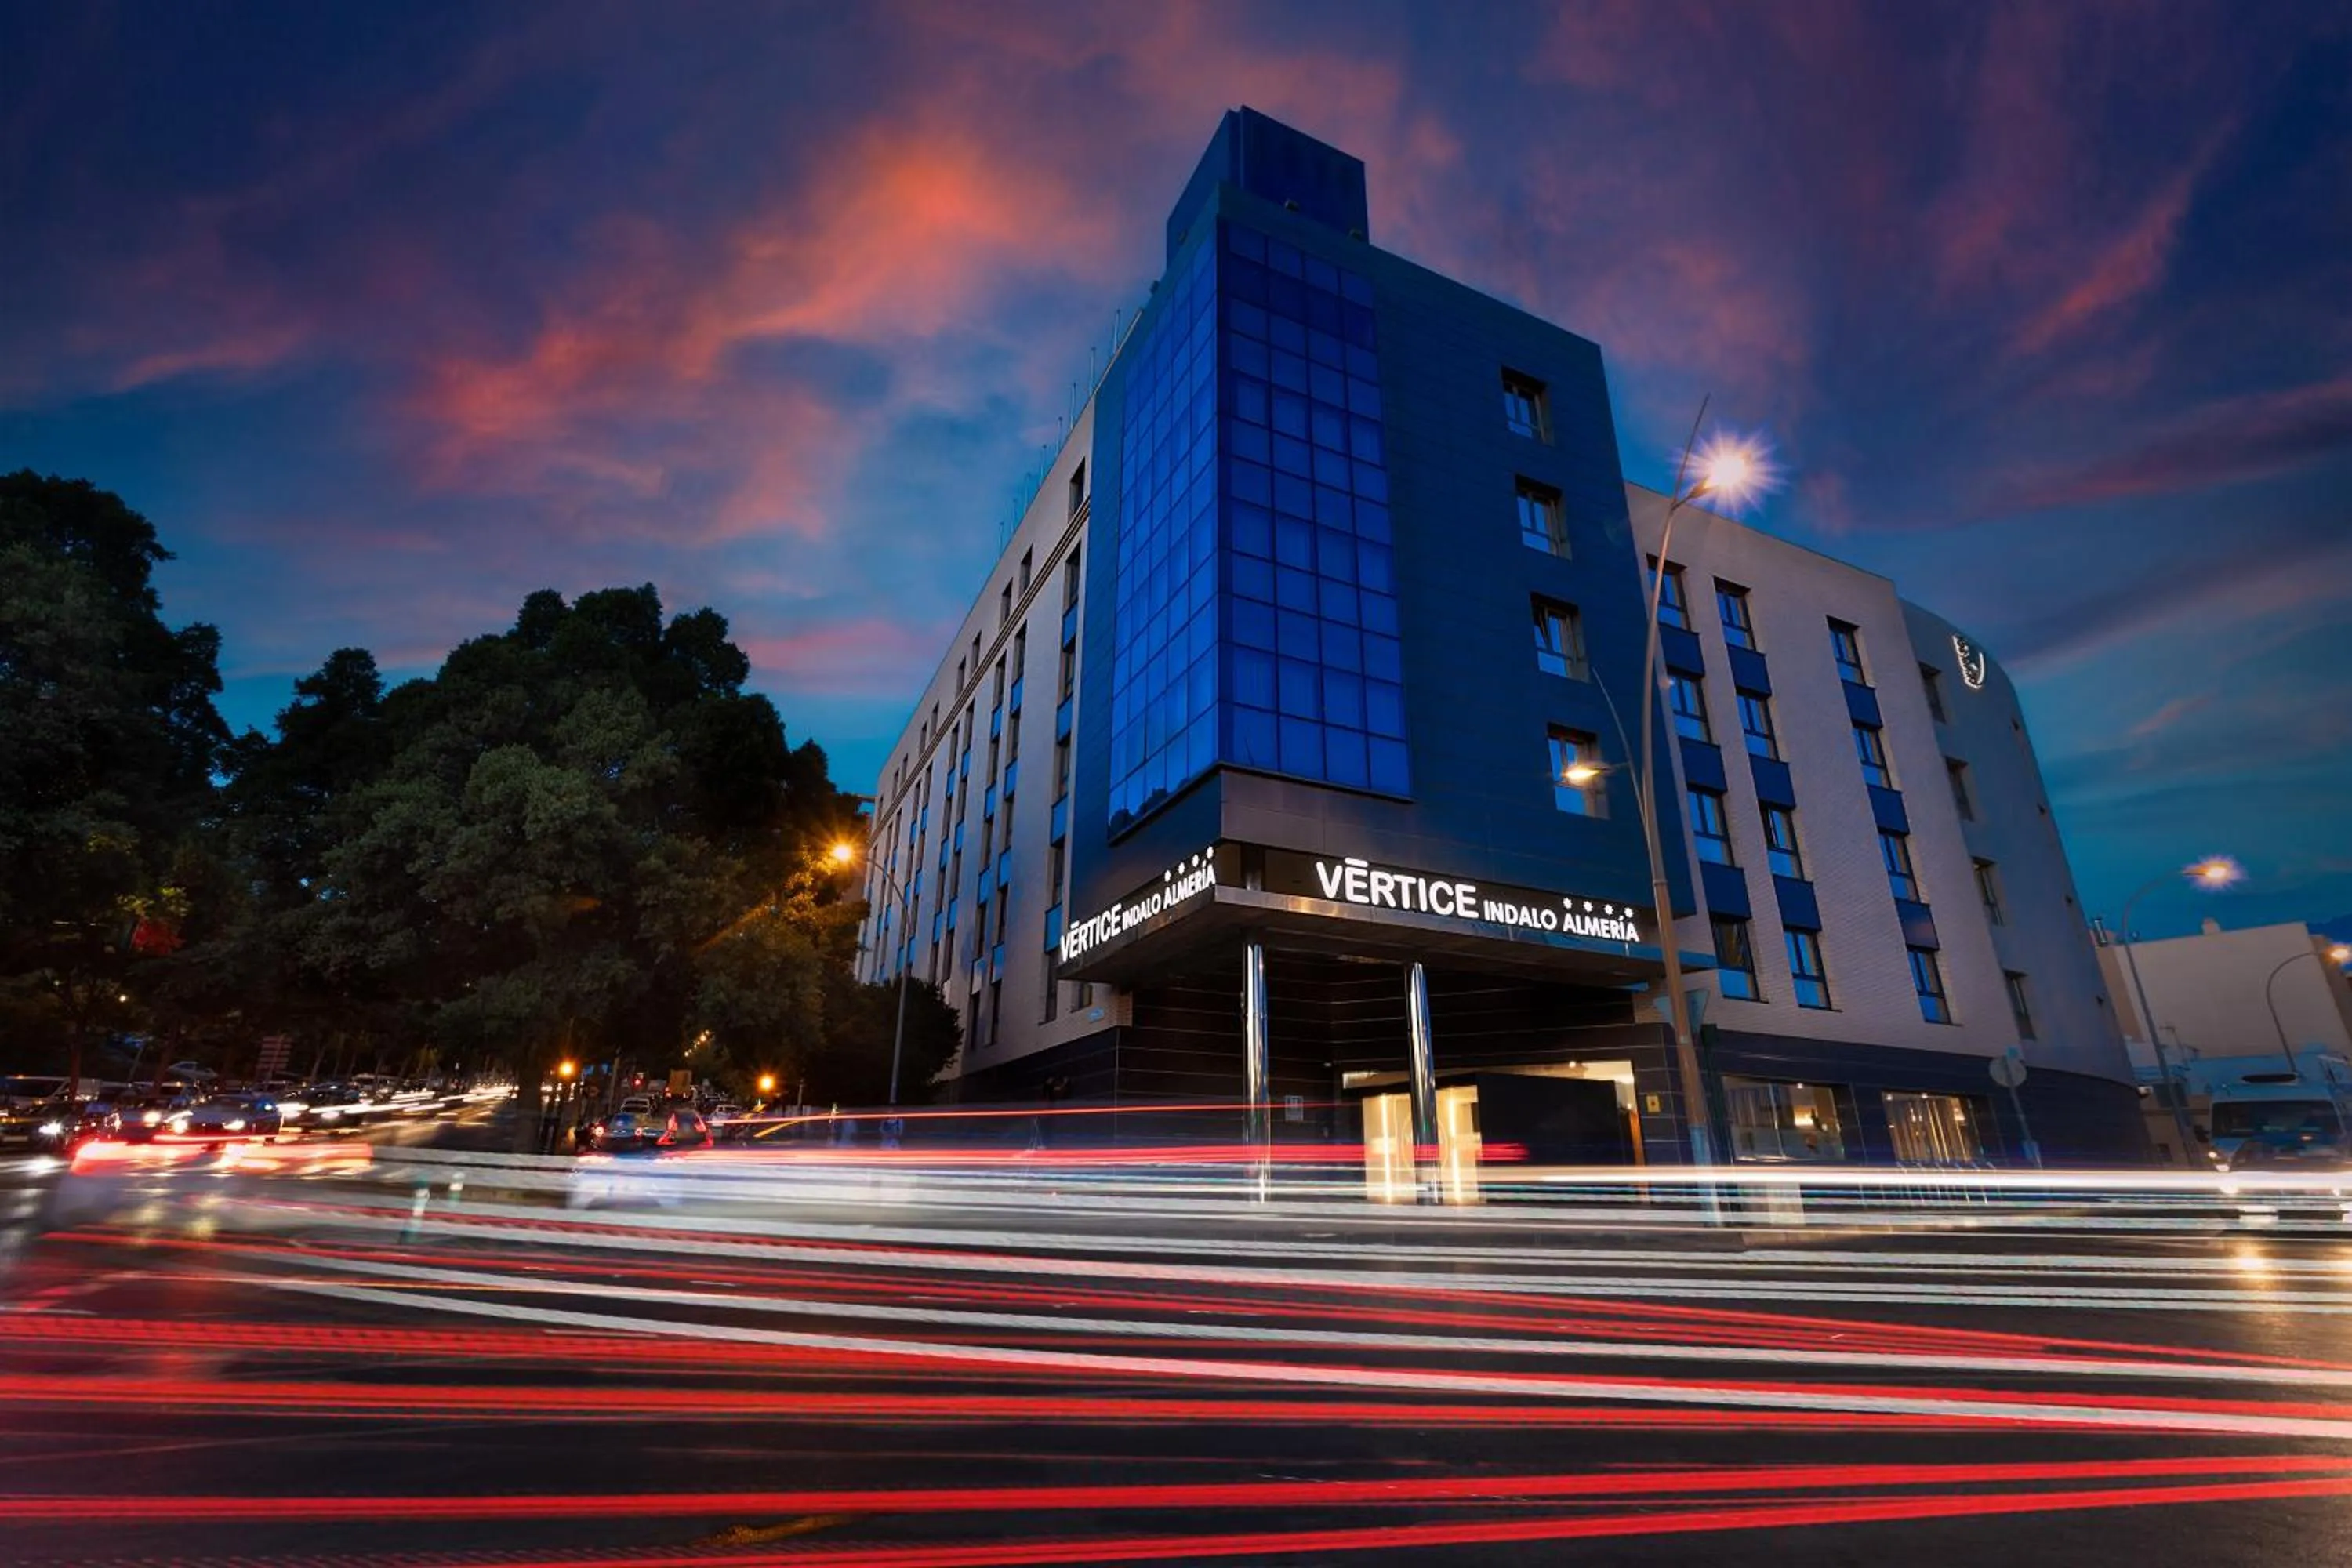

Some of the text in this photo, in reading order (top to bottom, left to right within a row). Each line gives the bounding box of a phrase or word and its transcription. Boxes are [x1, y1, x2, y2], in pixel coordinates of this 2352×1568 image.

[1123, 892, 1161, 931] INDALO
[1163, 859, 1216, 909] ALMERÍA
[1483, 899, 1558, 931] INDALO
[1563, 913, 1640, 942] ALMERÍA
